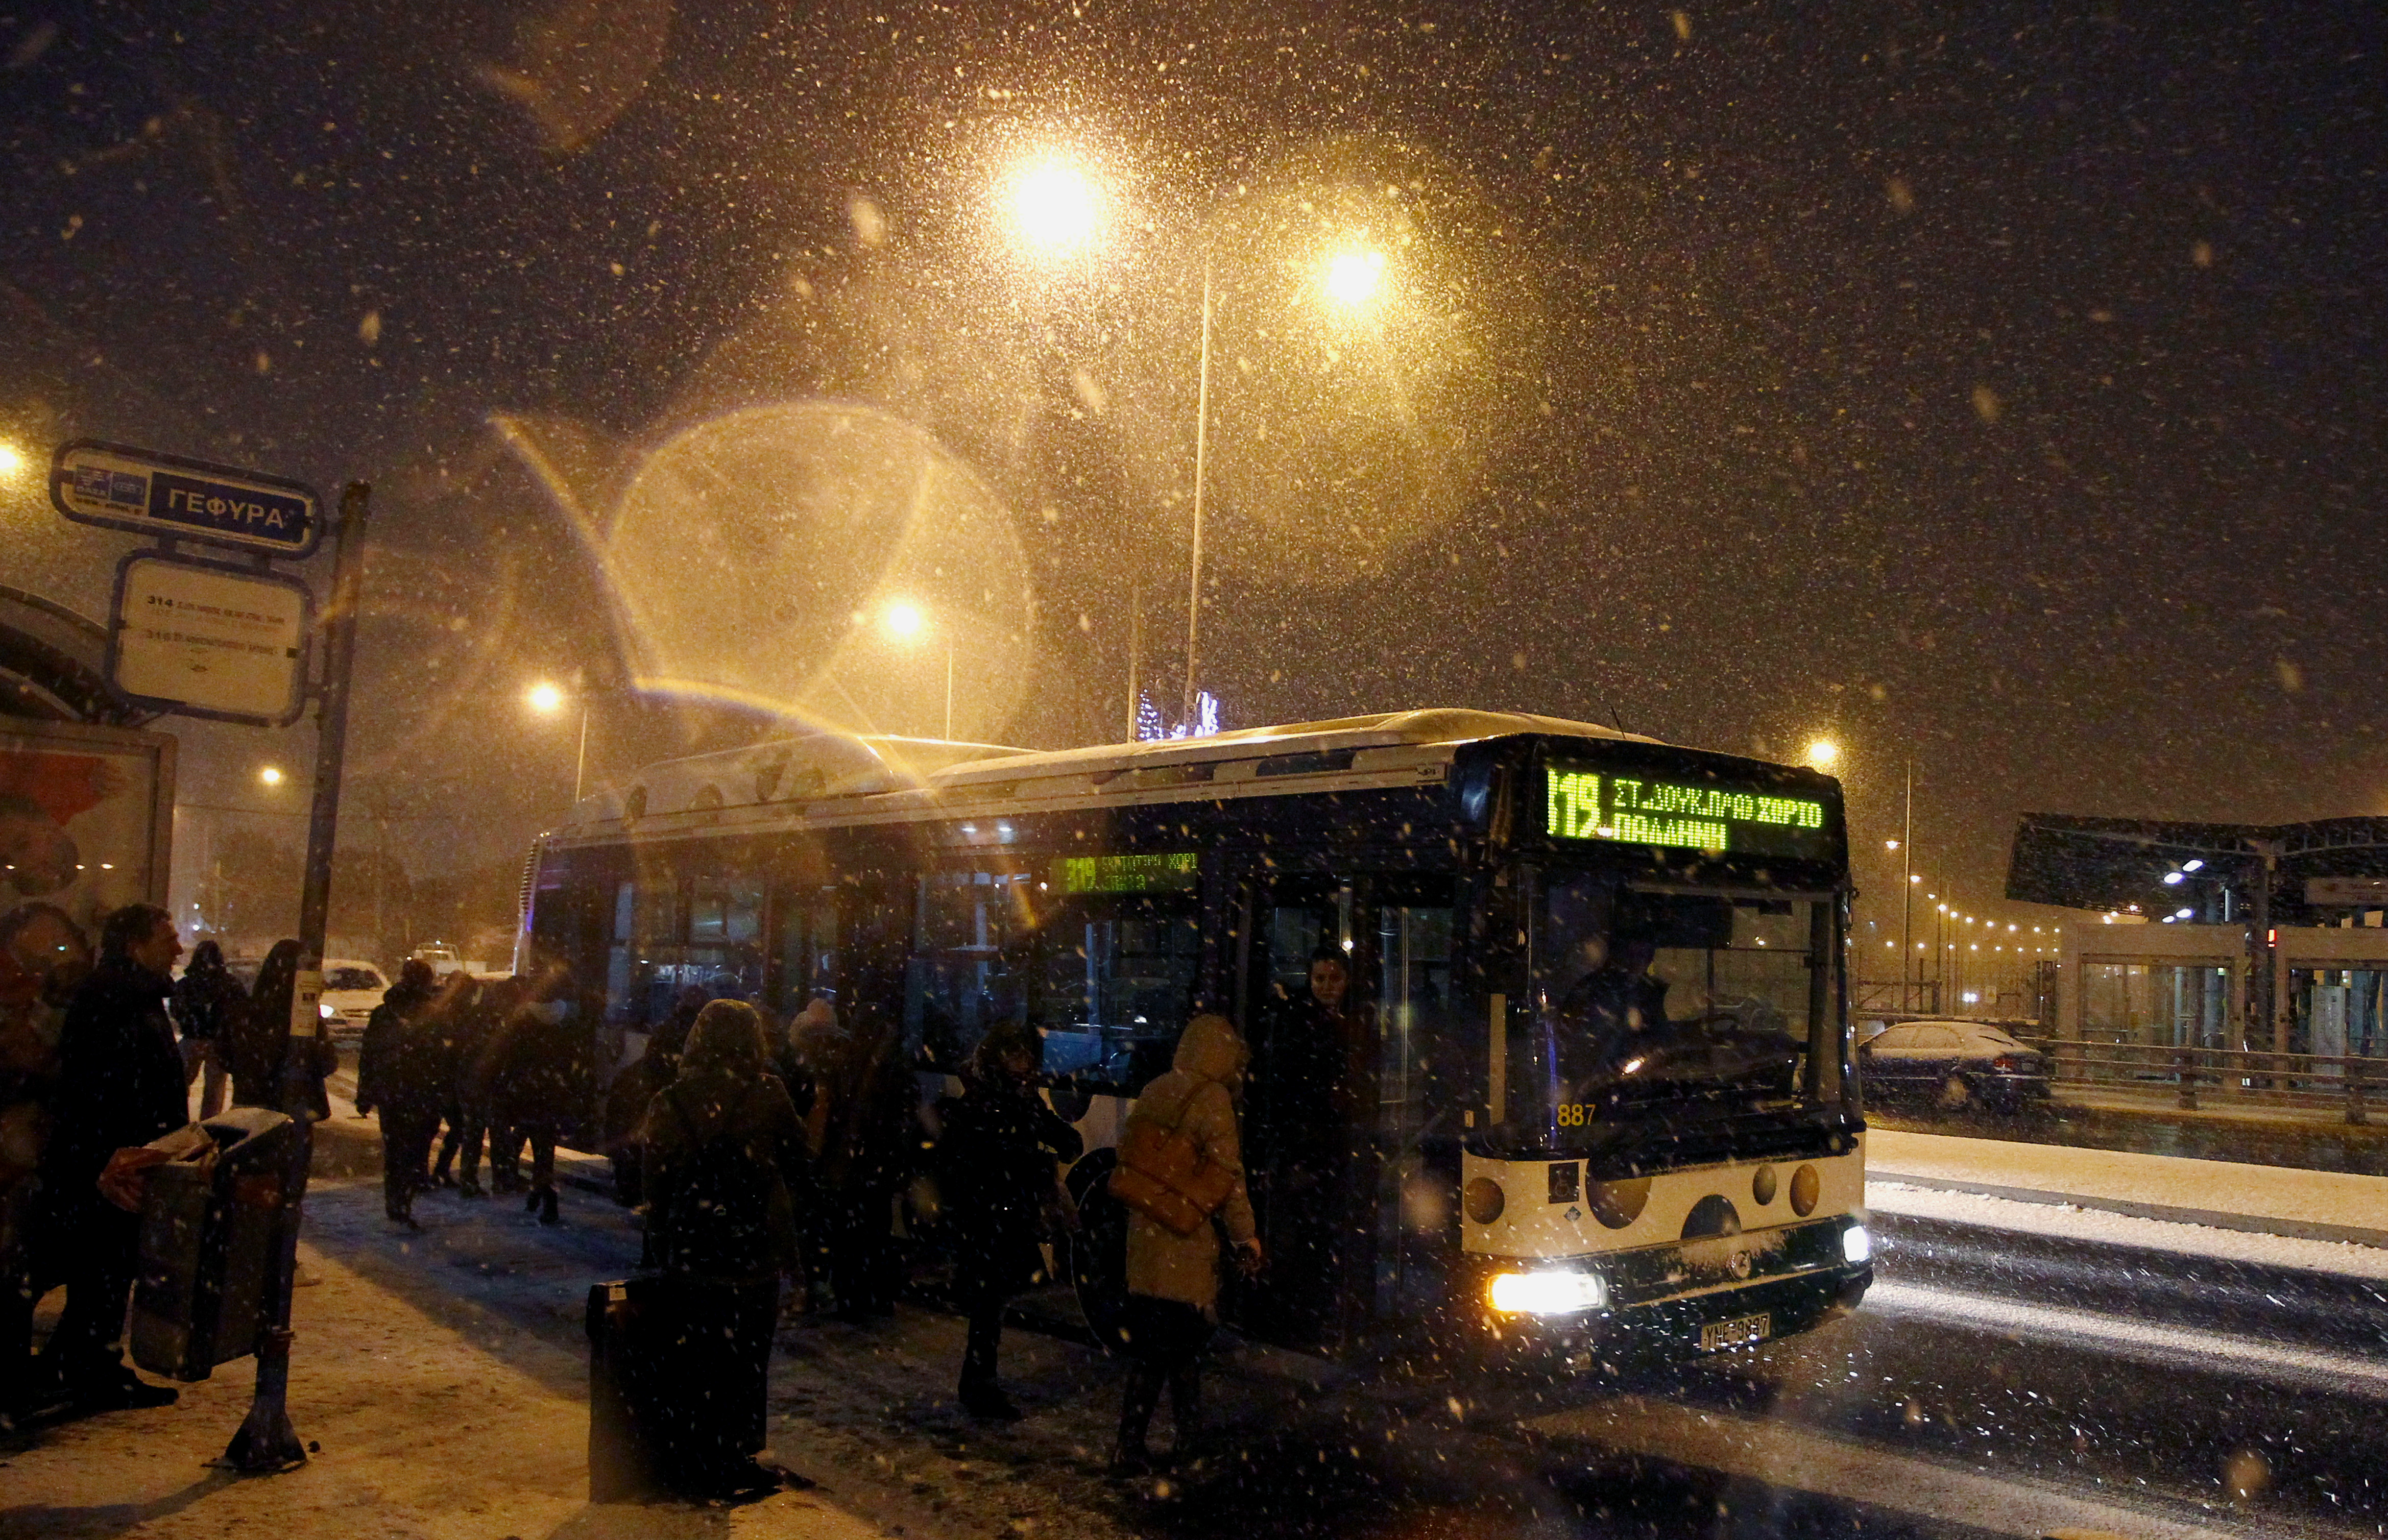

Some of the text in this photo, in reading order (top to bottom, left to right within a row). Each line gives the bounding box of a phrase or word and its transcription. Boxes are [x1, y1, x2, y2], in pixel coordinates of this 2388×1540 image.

[168, 488, 285, 529] ΓΕΦΥΡΑ
[147, 595, 174, 607] 314
[1557, 1104, 1596, 1127] 887
